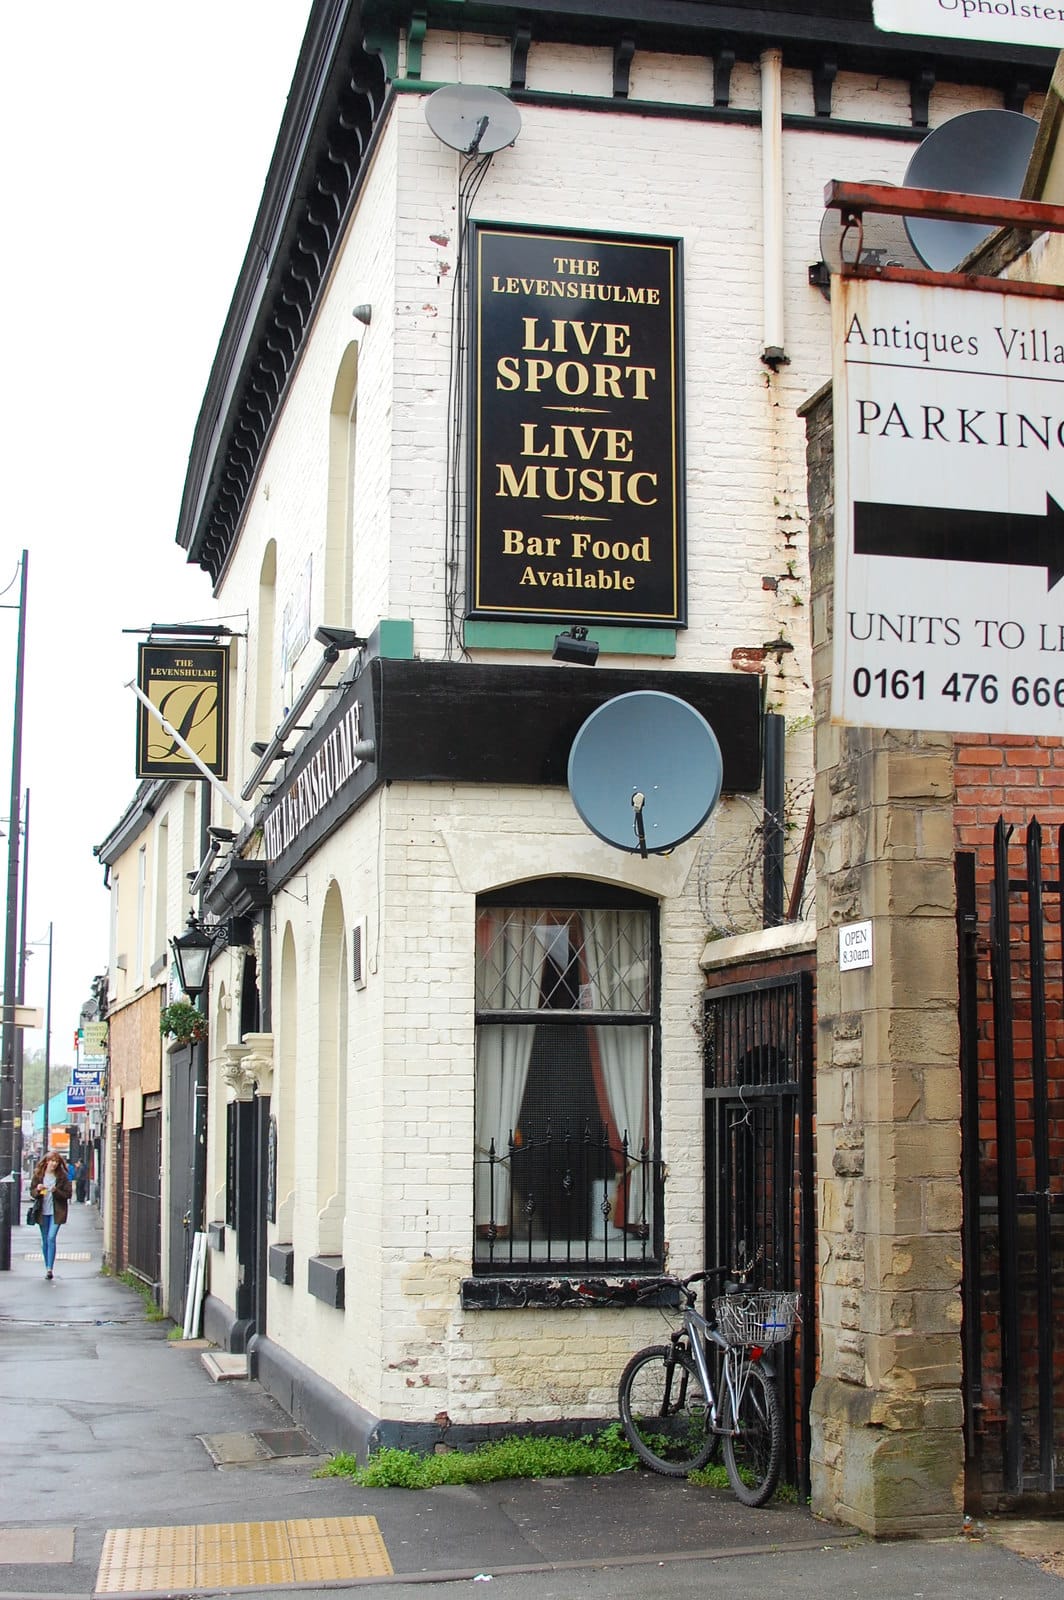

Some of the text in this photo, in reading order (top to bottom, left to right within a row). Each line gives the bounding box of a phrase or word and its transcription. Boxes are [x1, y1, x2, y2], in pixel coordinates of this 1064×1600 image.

[553, 257, 600, 277] THE
[492, 276, 660, 305] LEVENSHULME
[521, 317, 631, 357] LIVE
[844, 313, 979, 362] Antiques
[496, 357, 656, 400] SPORT
[520, 423, 633, 462] LIVE
[496, 463, 658, 505] MUSIC
[502, 529, 651, 562] Bar Food
[519, 566, 636, 591] Available
[848, 611, 961, 646] UNITS
[974, 620, 1025, 650] TO
[150, 668, 218, 677] LEVENSHULME
[174, 659, 194, 667] THE
[853, 667, 925, 700] 0161
[941, 672, 999, 704] 476
[844, 928, 867, 947] OPEN
